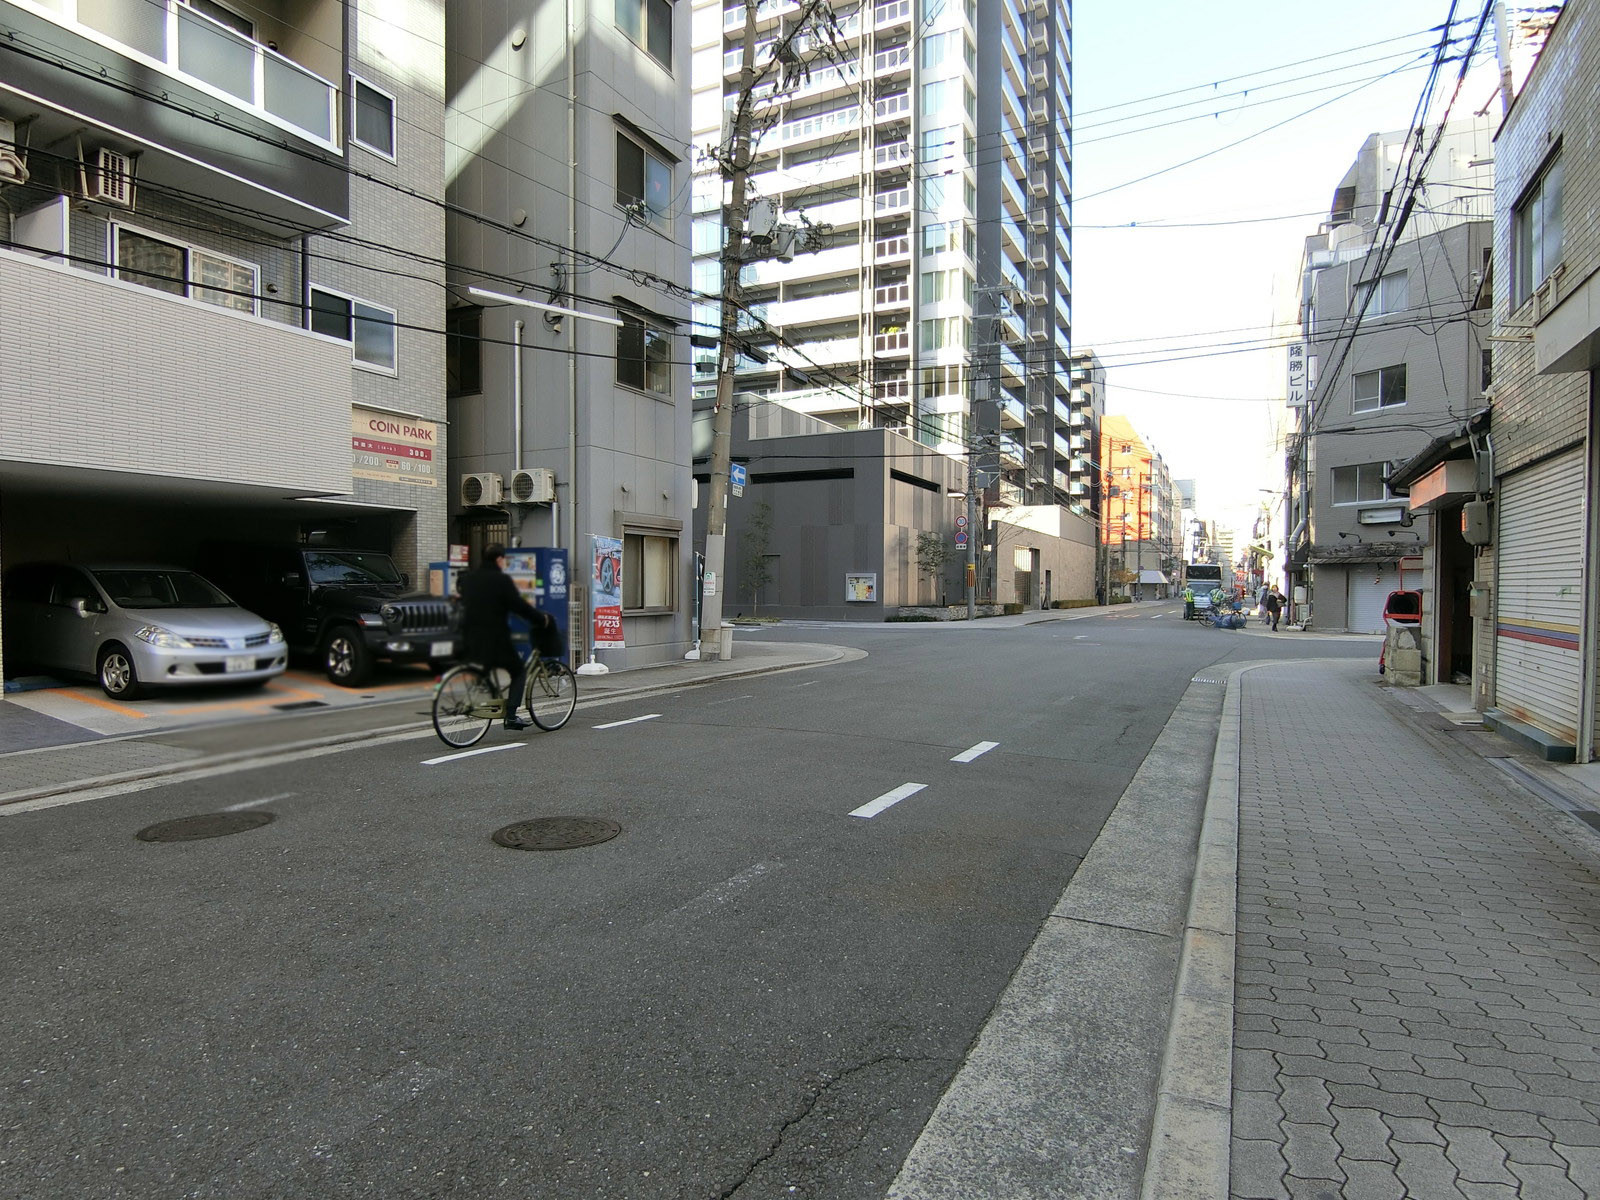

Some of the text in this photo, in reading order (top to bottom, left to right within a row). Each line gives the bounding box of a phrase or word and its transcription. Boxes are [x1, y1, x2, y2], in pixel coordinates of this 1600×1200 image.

[1289, 345, 1305, 401] 隆勝ビル
[369, 419, 432, 441] COIN PARK
[550, 585, 566, 594] BOSS
